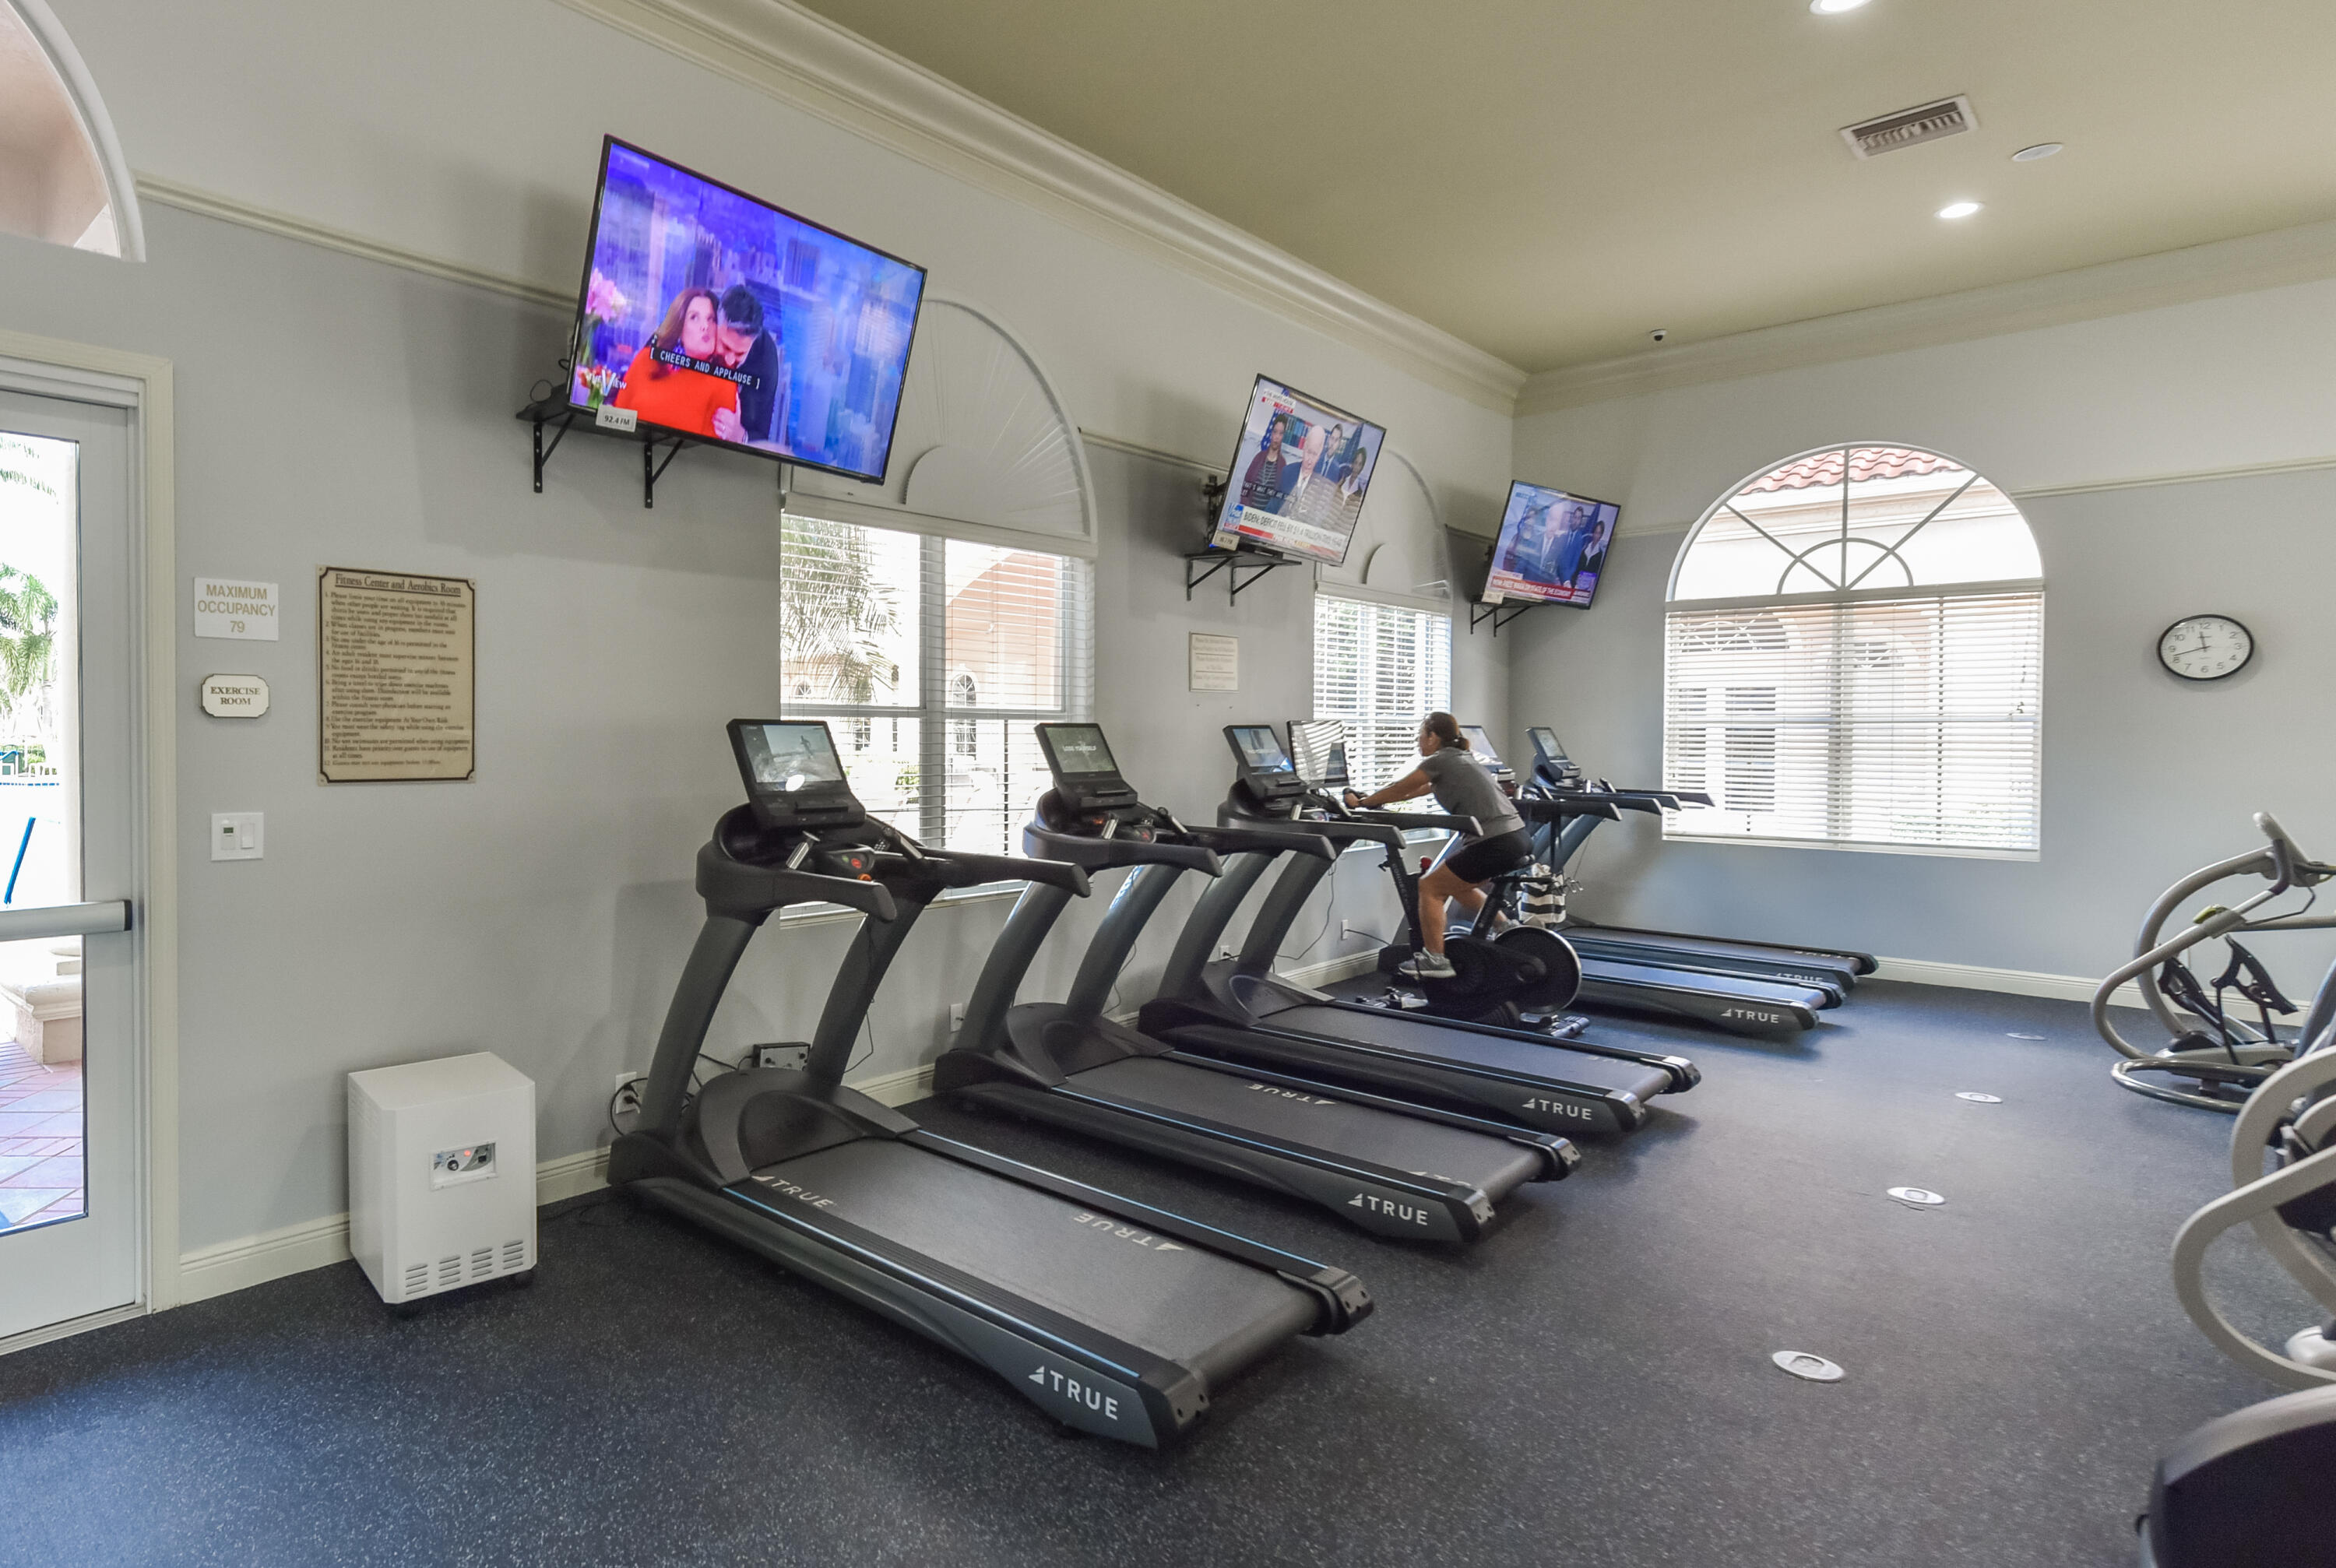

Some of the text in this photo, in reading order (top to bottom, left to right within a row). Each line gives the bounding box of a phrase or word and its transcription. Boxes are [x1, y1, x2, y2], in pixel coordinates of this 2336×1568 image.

[660, 350, 691, 367] CHEERS
[694, 360, 710, 374] AND
[713, 366, 752, 385] APPLAUSE
[206, 584, 267, 599] MAXIMUM
[336, 573, 461, 595] Fitness Center and Aerobics Room
[197, 599, 276, 617] OCCUPANCY
[230, 621, 245, 633] 79
[2184, 663, 2192, 673] 7
[210, 686, 261, 695] EXERCISE
[220, 697, 252, 705] ROOM
[1735, 1009, 1780, 1024] TRUE
[1539, 1099, 1592, 1121] TRUE
[771, 1179, 834, 1208] TRUE
[1367, 1195, 1428, 1225] TRUE
[1073, 1213, 1152, 1246] TRUE
[1050, 1369, 1118, 1421] TRUE
